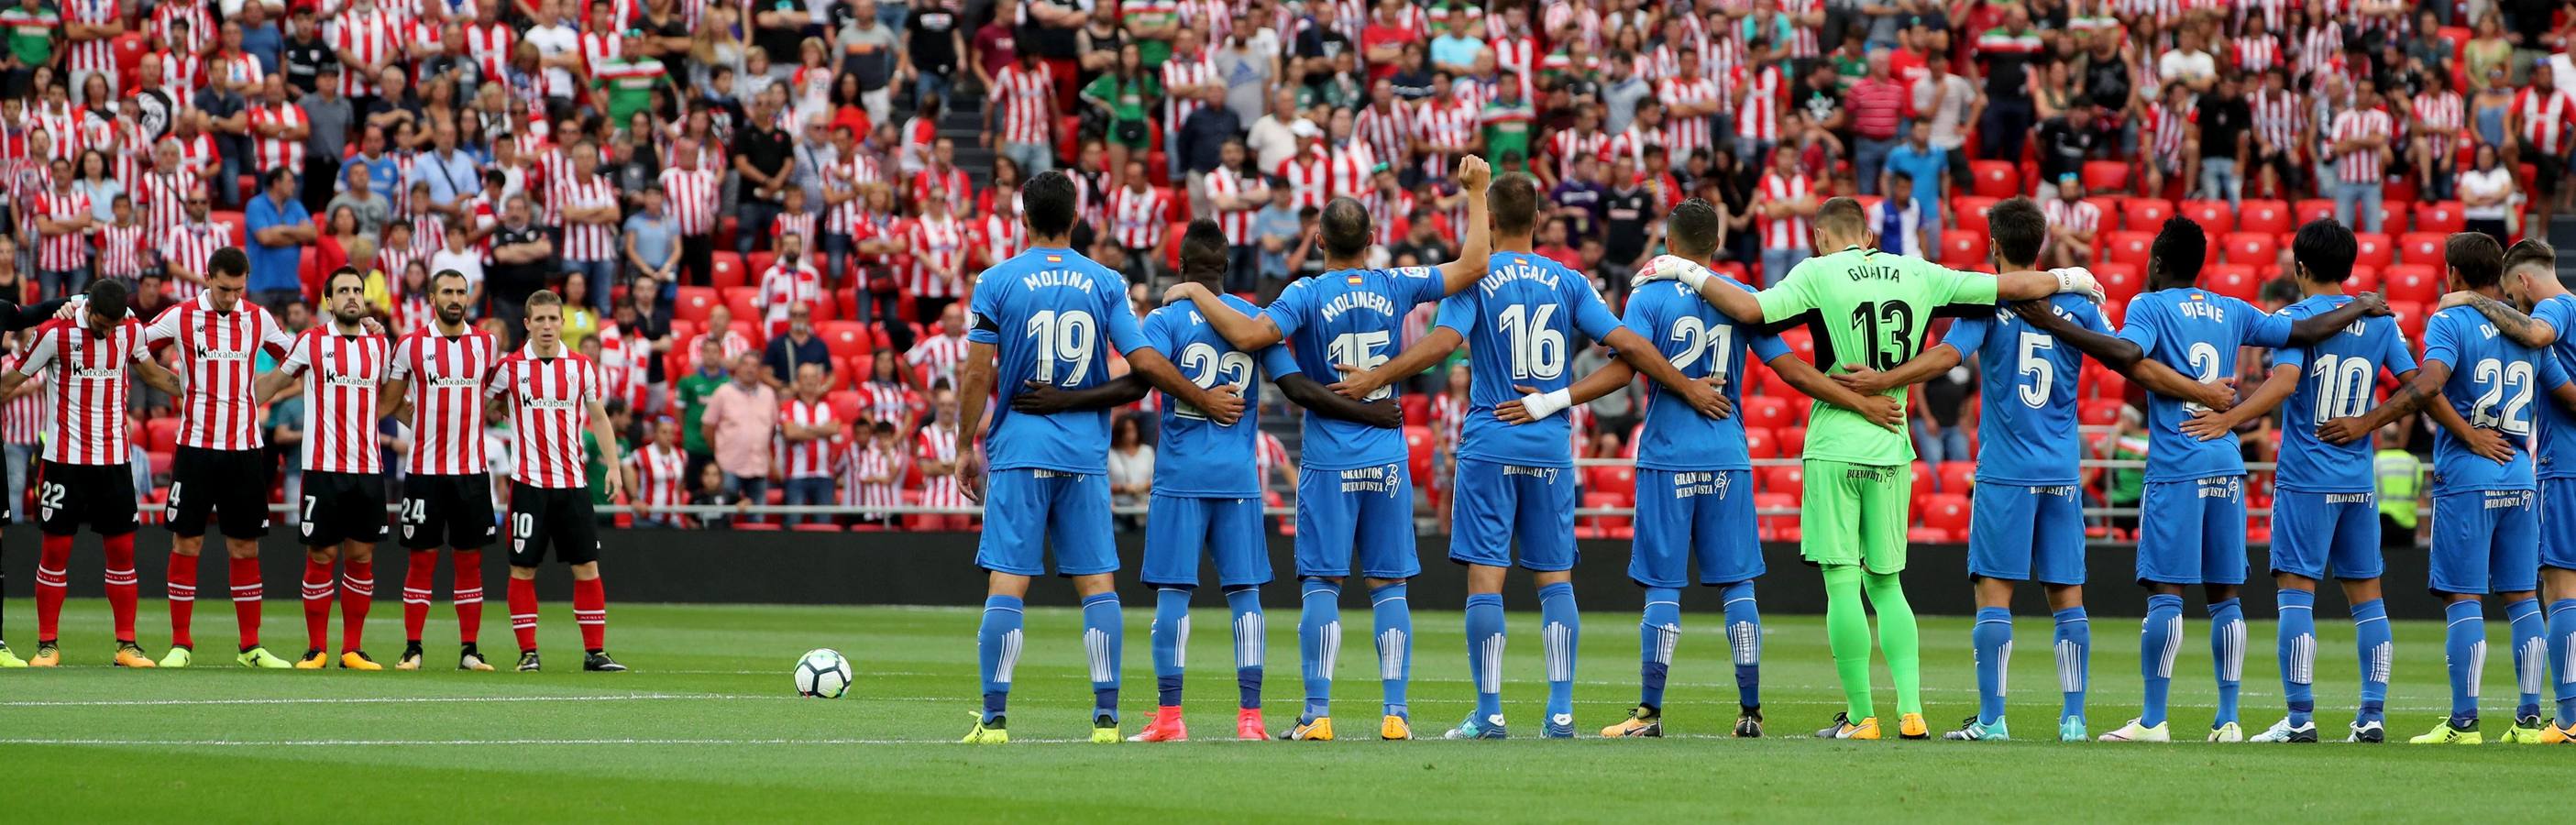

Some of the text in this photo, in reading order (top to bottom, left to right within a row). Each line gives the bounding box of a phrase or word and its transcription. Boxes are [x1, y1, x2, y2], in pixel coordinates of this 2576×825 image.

[1023, 270, 1094, 295] MOLINA
[1480, 265, 1559, 299] JUAN CALA
[1847, 266, 1900, 283] GUAITA
[1321, 291, 1394, 323] MOLINERO
[2179, 302, 2224, 324] DJENE
[1027, 310, 1095, 387] 19
[1499, 303, 1565, 380] 16
[1670, 316, 1732, 394] 21
[1852, 300, 1912, 379] 13
[1328, 330, 1392, 403] 15
[2019, 331, 2053, 409] 5
[2182, 342, 2219, 417] 2
[2310, 353, 2372, 427] 10
[2471, 358, 2533, 436] 22
[41, 480, 65, 509] 22
[170, 481, 182, 506] 4
[304, 495, 316, 521] 7
[401, 497, 426, 524] 24
[511, 512, 534, 538] 10
